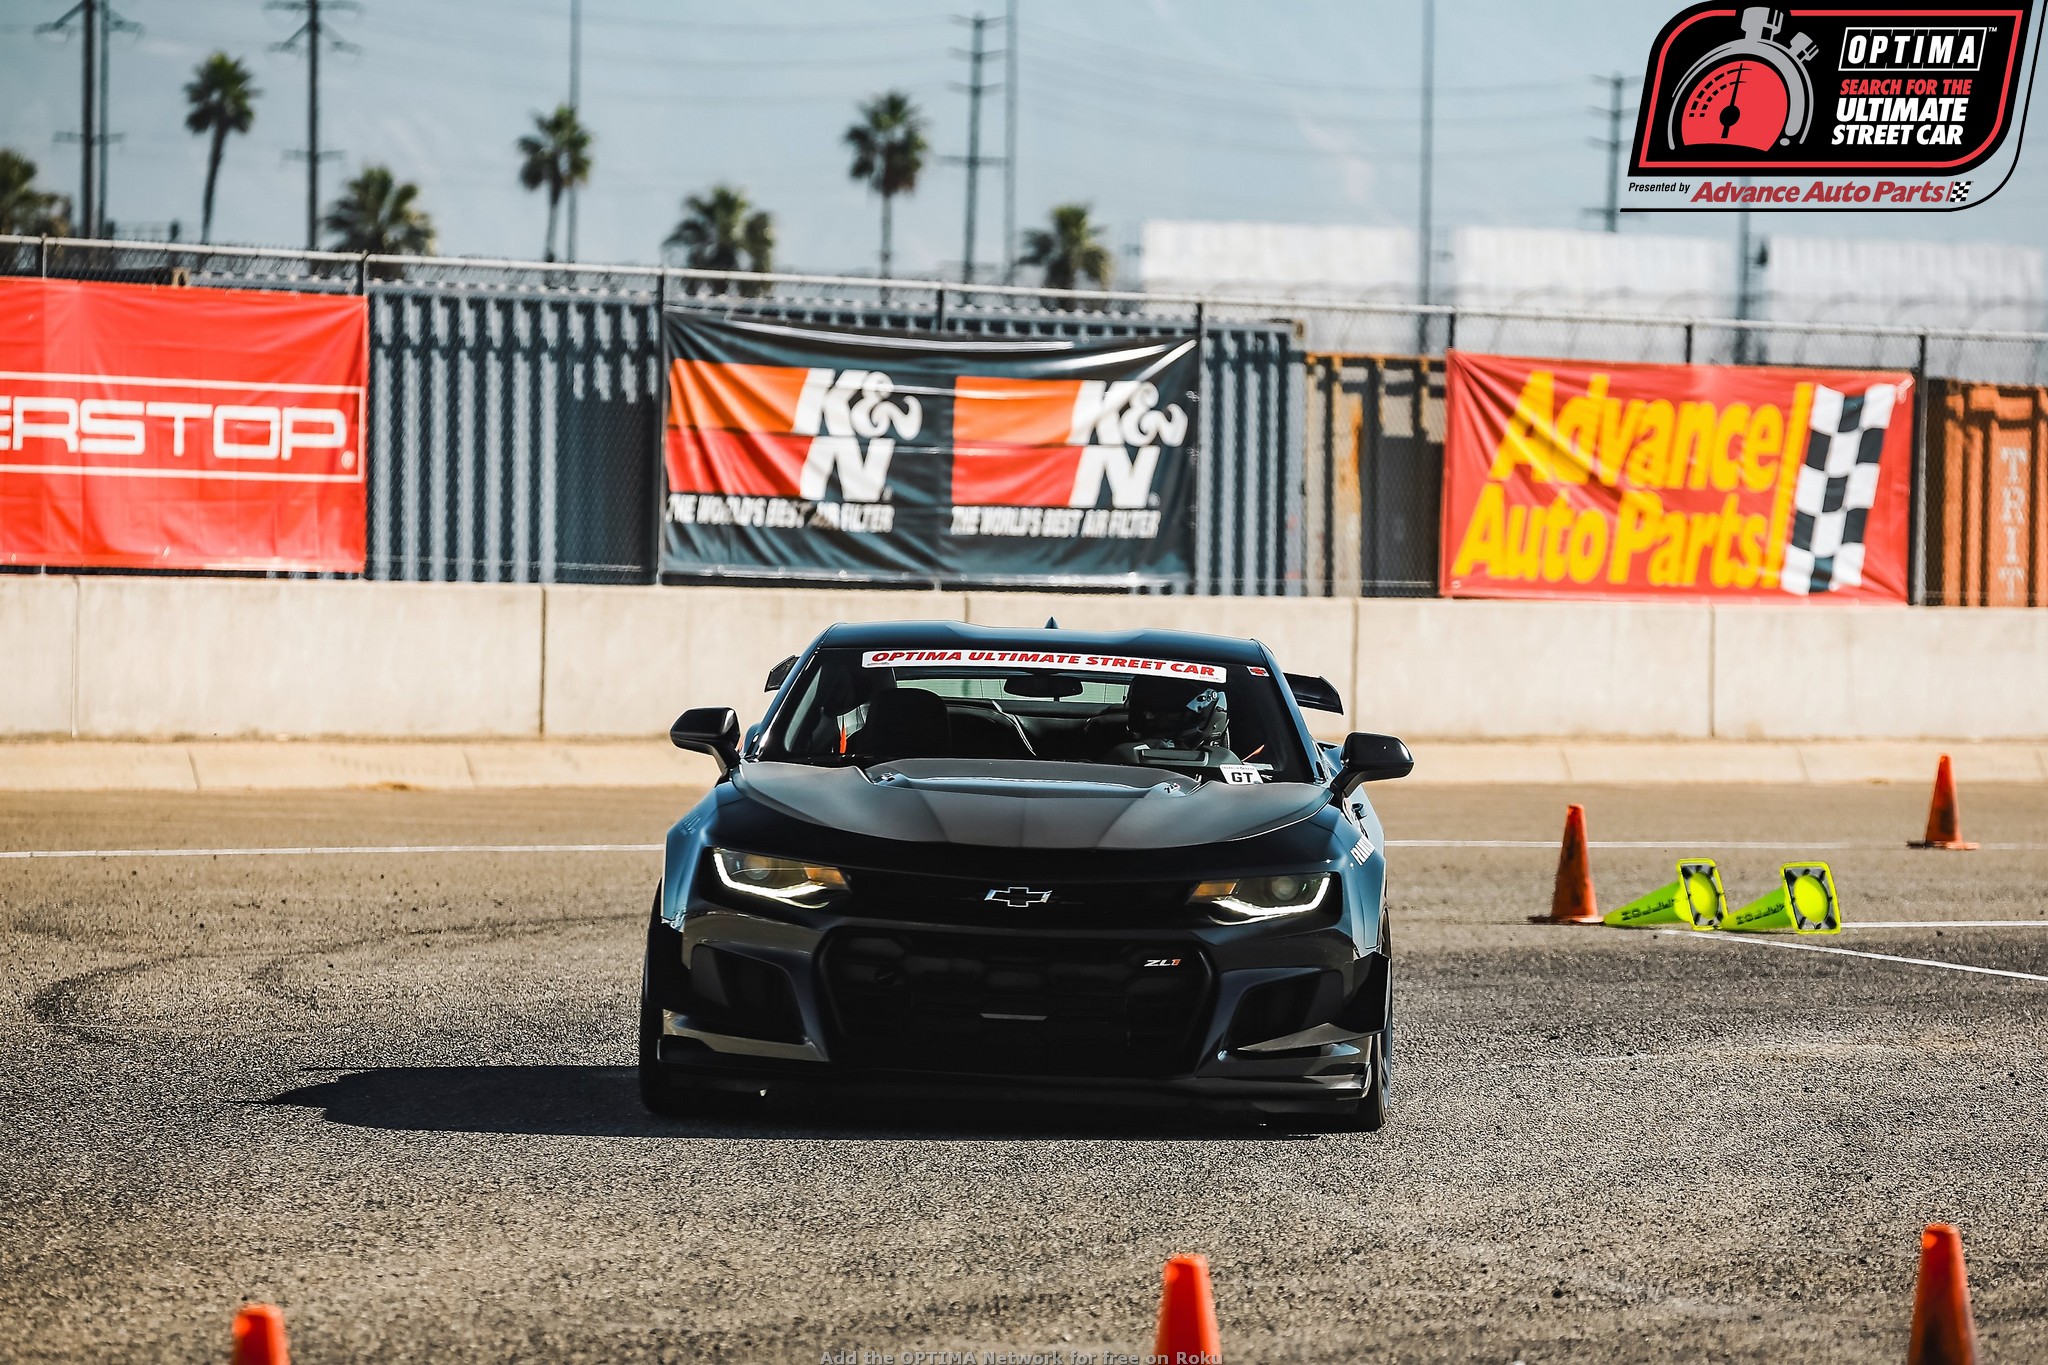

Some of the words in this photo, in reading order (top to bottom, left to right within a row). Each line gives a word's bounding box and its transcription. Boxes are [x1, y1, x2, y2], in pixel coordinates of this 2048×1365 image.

[1489, 371, 1784, 492] Advance
[1108, 509, 1161, 539] FILTER
[1453, 484, 1608, 582] Auto
[1607, 490, 1767, 587] Parts
[872, 652, 962, 662] OPTIMA
[968, 652, 1081, 664] ULTIMATE
[1085, 657, 1166, 670] STREET
[1170, 663, 1215, 676] CAR
[1231, 772, 1253, 783] GT
[1144, 959, 1181, 967] ZL1
